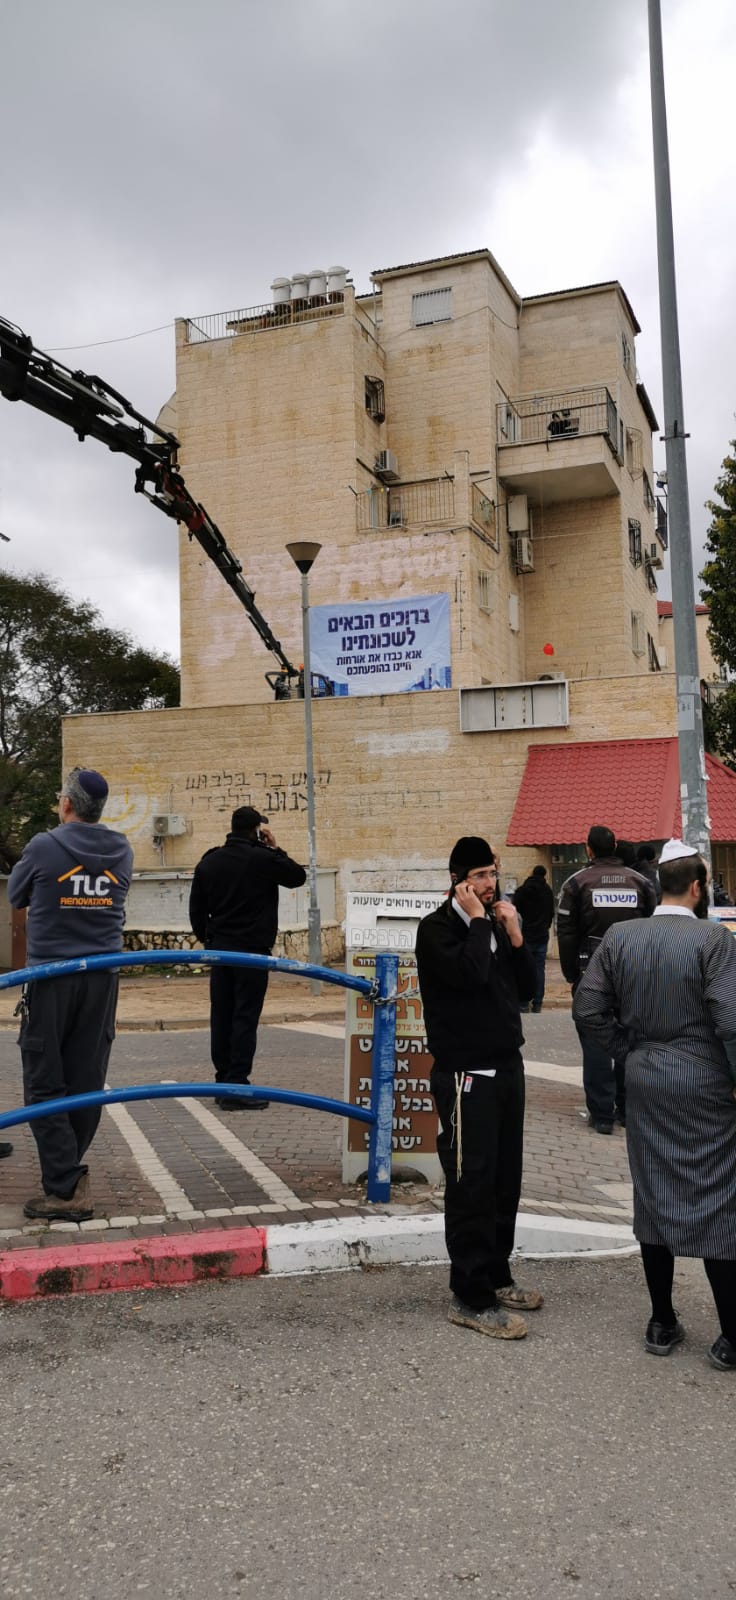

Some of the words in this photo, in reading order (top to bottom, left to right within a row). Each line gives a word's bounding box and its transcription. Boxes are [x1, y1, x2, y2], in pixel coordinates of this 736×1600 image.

[380, 608, 430, 627] ברוכים
[328, 614, 375, 633] הבאים
[342, 627, 416, 651] לשכונתינו
[368, 654, 380, 662] את
[383, 653, 402, 661] כבדו
[405, 649, 422, 659] אנא
[336, 654, 365, 666] אורחות
[346, 664, 390, 675] בהופעתכם
[70, 874, 110, 896] TLC
[353, 896, 384, 906] ישועות
[386, 897, 412, 908] ורואים
[594, 894, 637, 903] משטרה
[359, 1078, 431, 1092] הדמת
[400, 1095, 433, 1111] בכל
